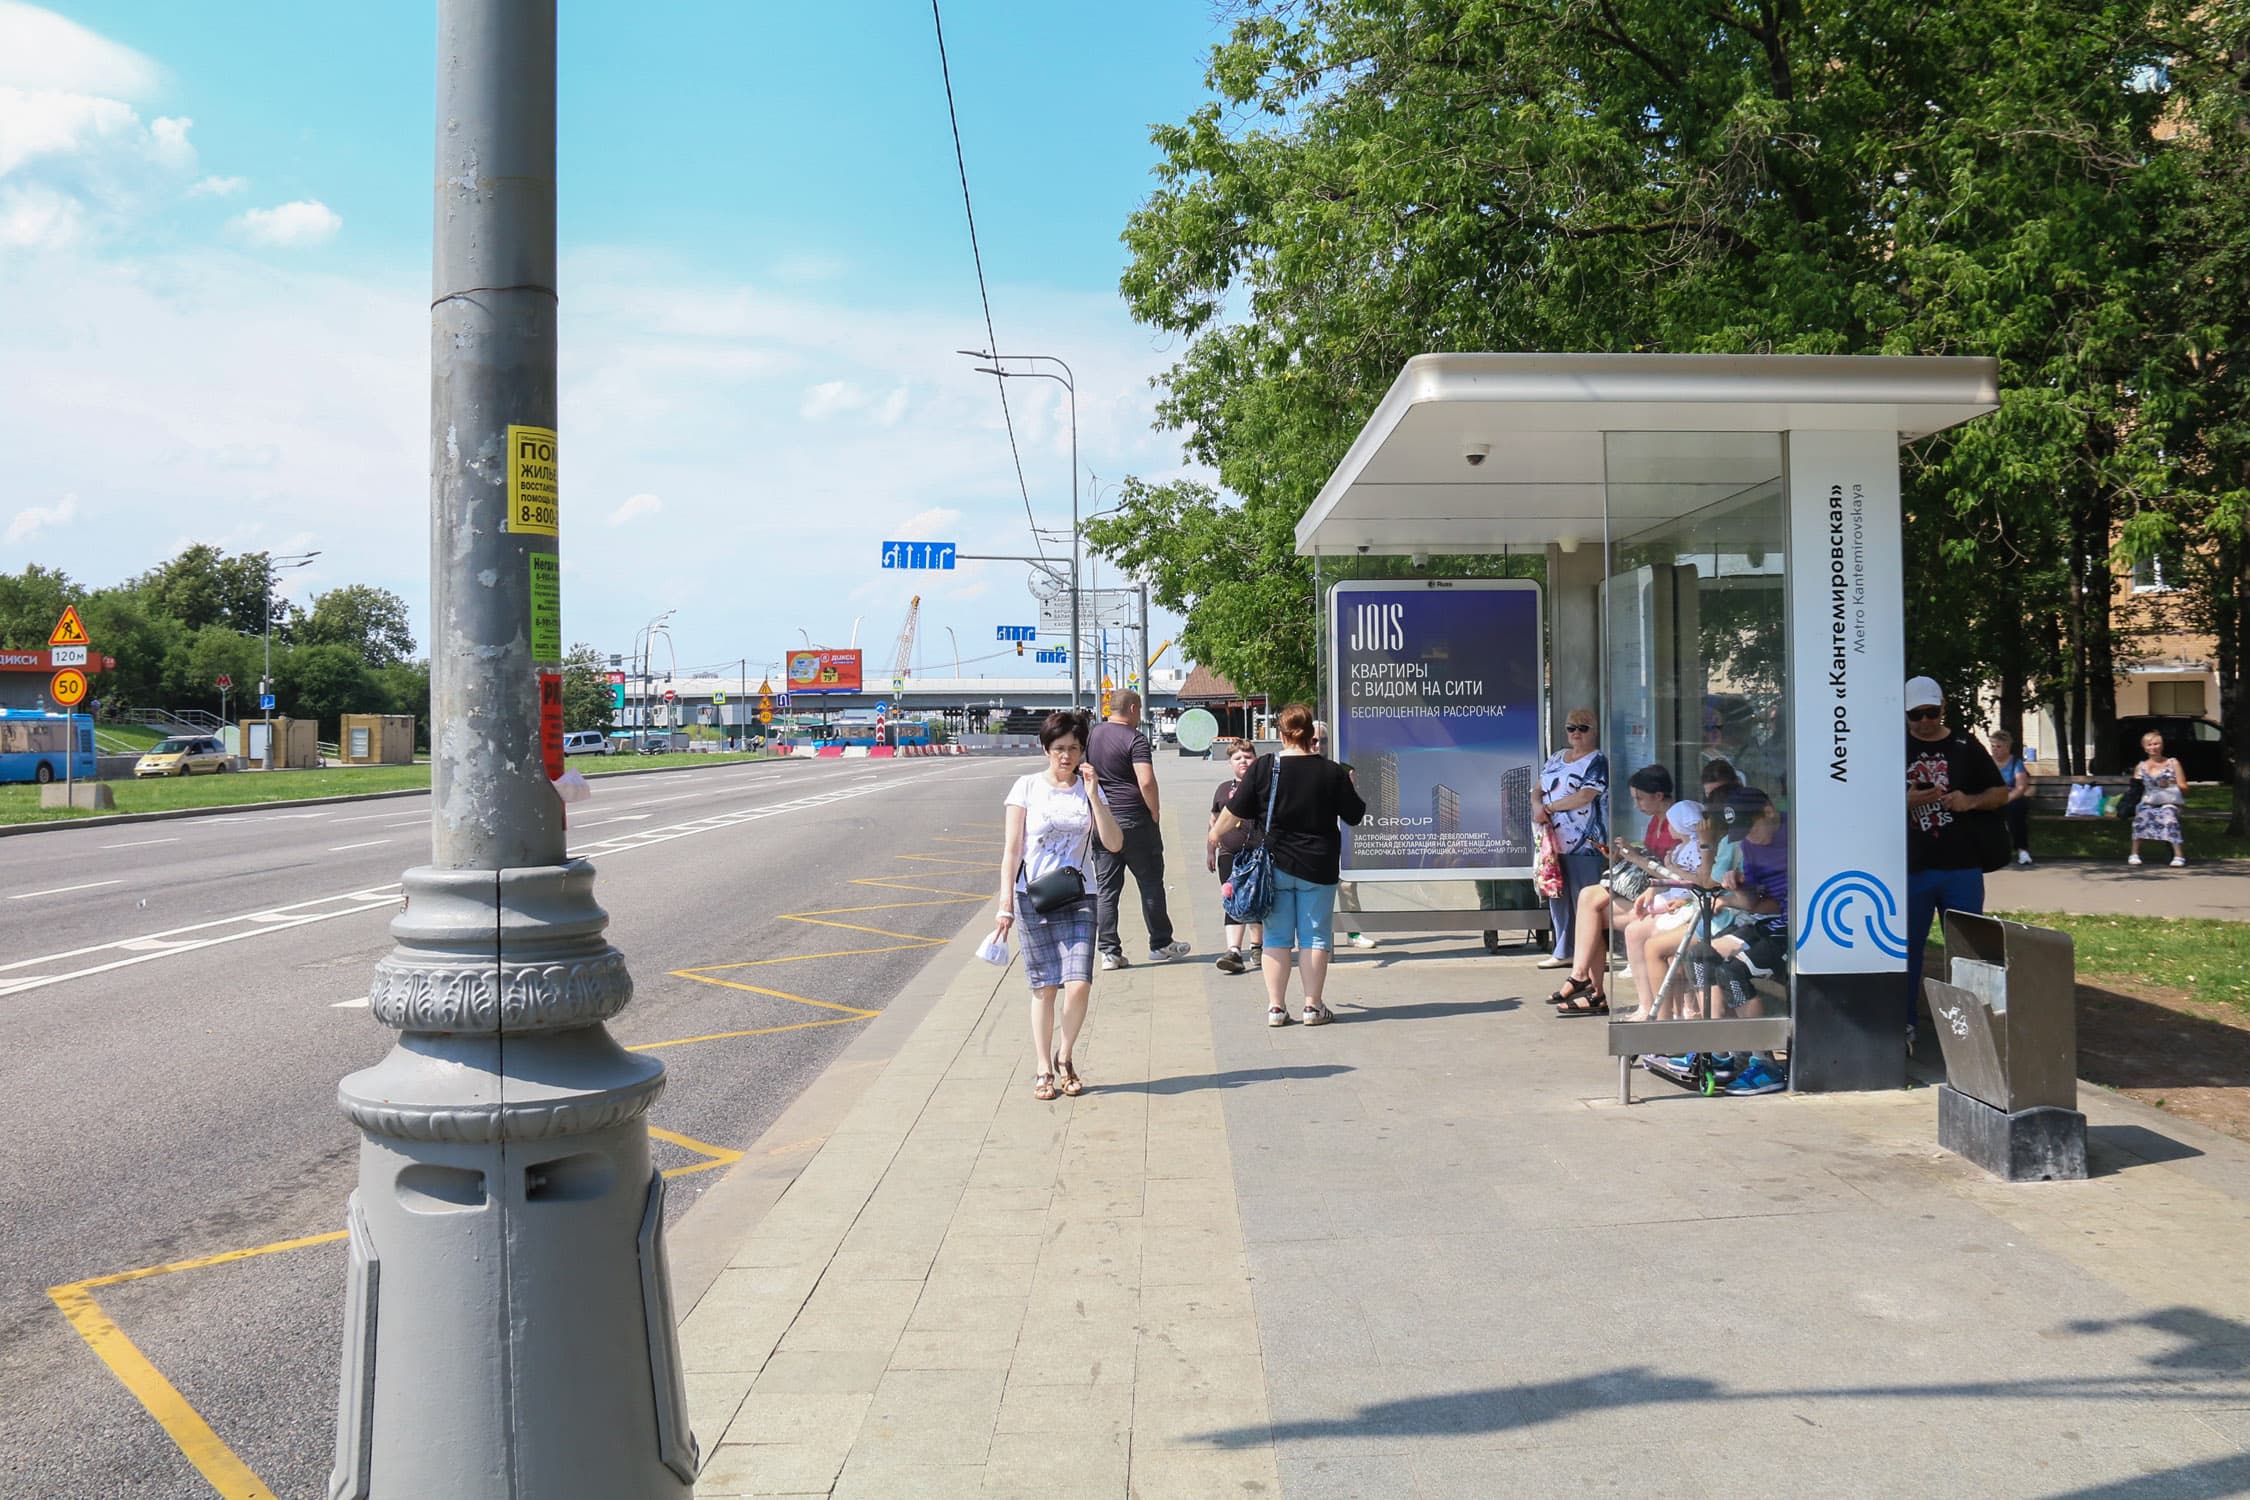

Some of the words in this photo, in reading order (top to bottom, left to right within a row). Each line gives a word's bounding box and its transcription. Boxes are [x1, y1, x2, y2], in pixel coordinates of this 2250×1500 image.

[1850, 484, 1865, 605] Kantemirovskaya
[1829, 484, 1848, 699] «Кантемировская»
[1351, 603, 1404, 651] JOIS
[1853, 609, 1865, 654] Metro
[1351, 663, 1428, 679] КВАРТИРЫ
[59, 680, 79, 695] 50
[1351, 681, 1361, 697] С
[1365, 681, 1417, 698] ВИДОМ
[1422, 681, 1441, 696] НА
[1445, 680, 1483, 696] СИТИ
[1351, 706, 1440, 719] БЕСПРОЦЕНТНАЯ
[1829, 705, 1851, 783] Метро
[1358, 814, 1374, 826] R
[1377, 817, 1433, 826] GROUP
[1354, 833, 1399, 842] ЗАСТРОЙЩИК
[1354, 841, 1393, 849] ПРОЕКТНАЯ
[1393, 841, 1436, 849] ДЕКЛАРАЦИЯ
[1447, 840, 1467, 848] САЙТЕ
[1398, 848, 1405, 856] ОТ
